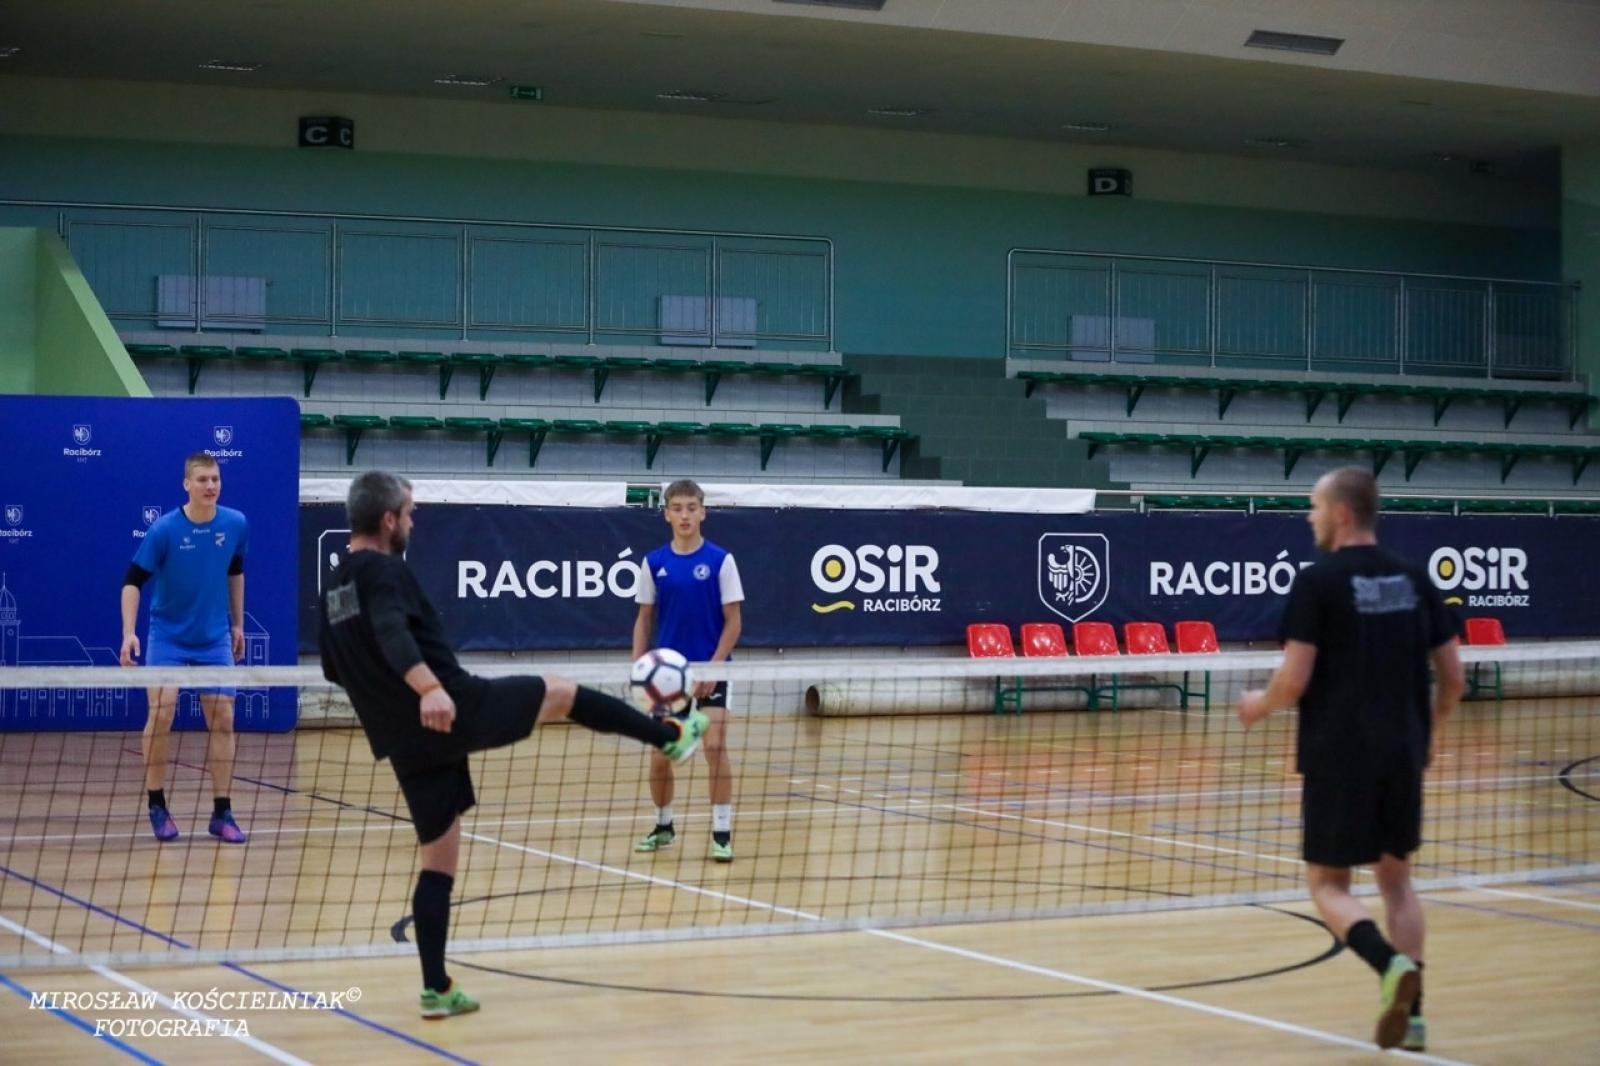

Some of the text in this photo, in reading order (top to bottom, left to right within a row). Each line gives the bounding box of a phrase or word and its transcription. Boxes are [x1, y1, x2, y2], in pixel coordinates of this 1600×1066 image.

[305, 126, 328, 144] C
[340, 128, 351, 145] C
[1095, 177, 1118, 192] D
[63, 447, 102, 456] Racibórz
[0, 528, 33, 537] acibórz
[1149, 549, 1315, 597] RACIBÓ
[863, 595, 941, 612] RACIBÓRZ
[1468, 592, 1530, 608] RACIBÓRZ
